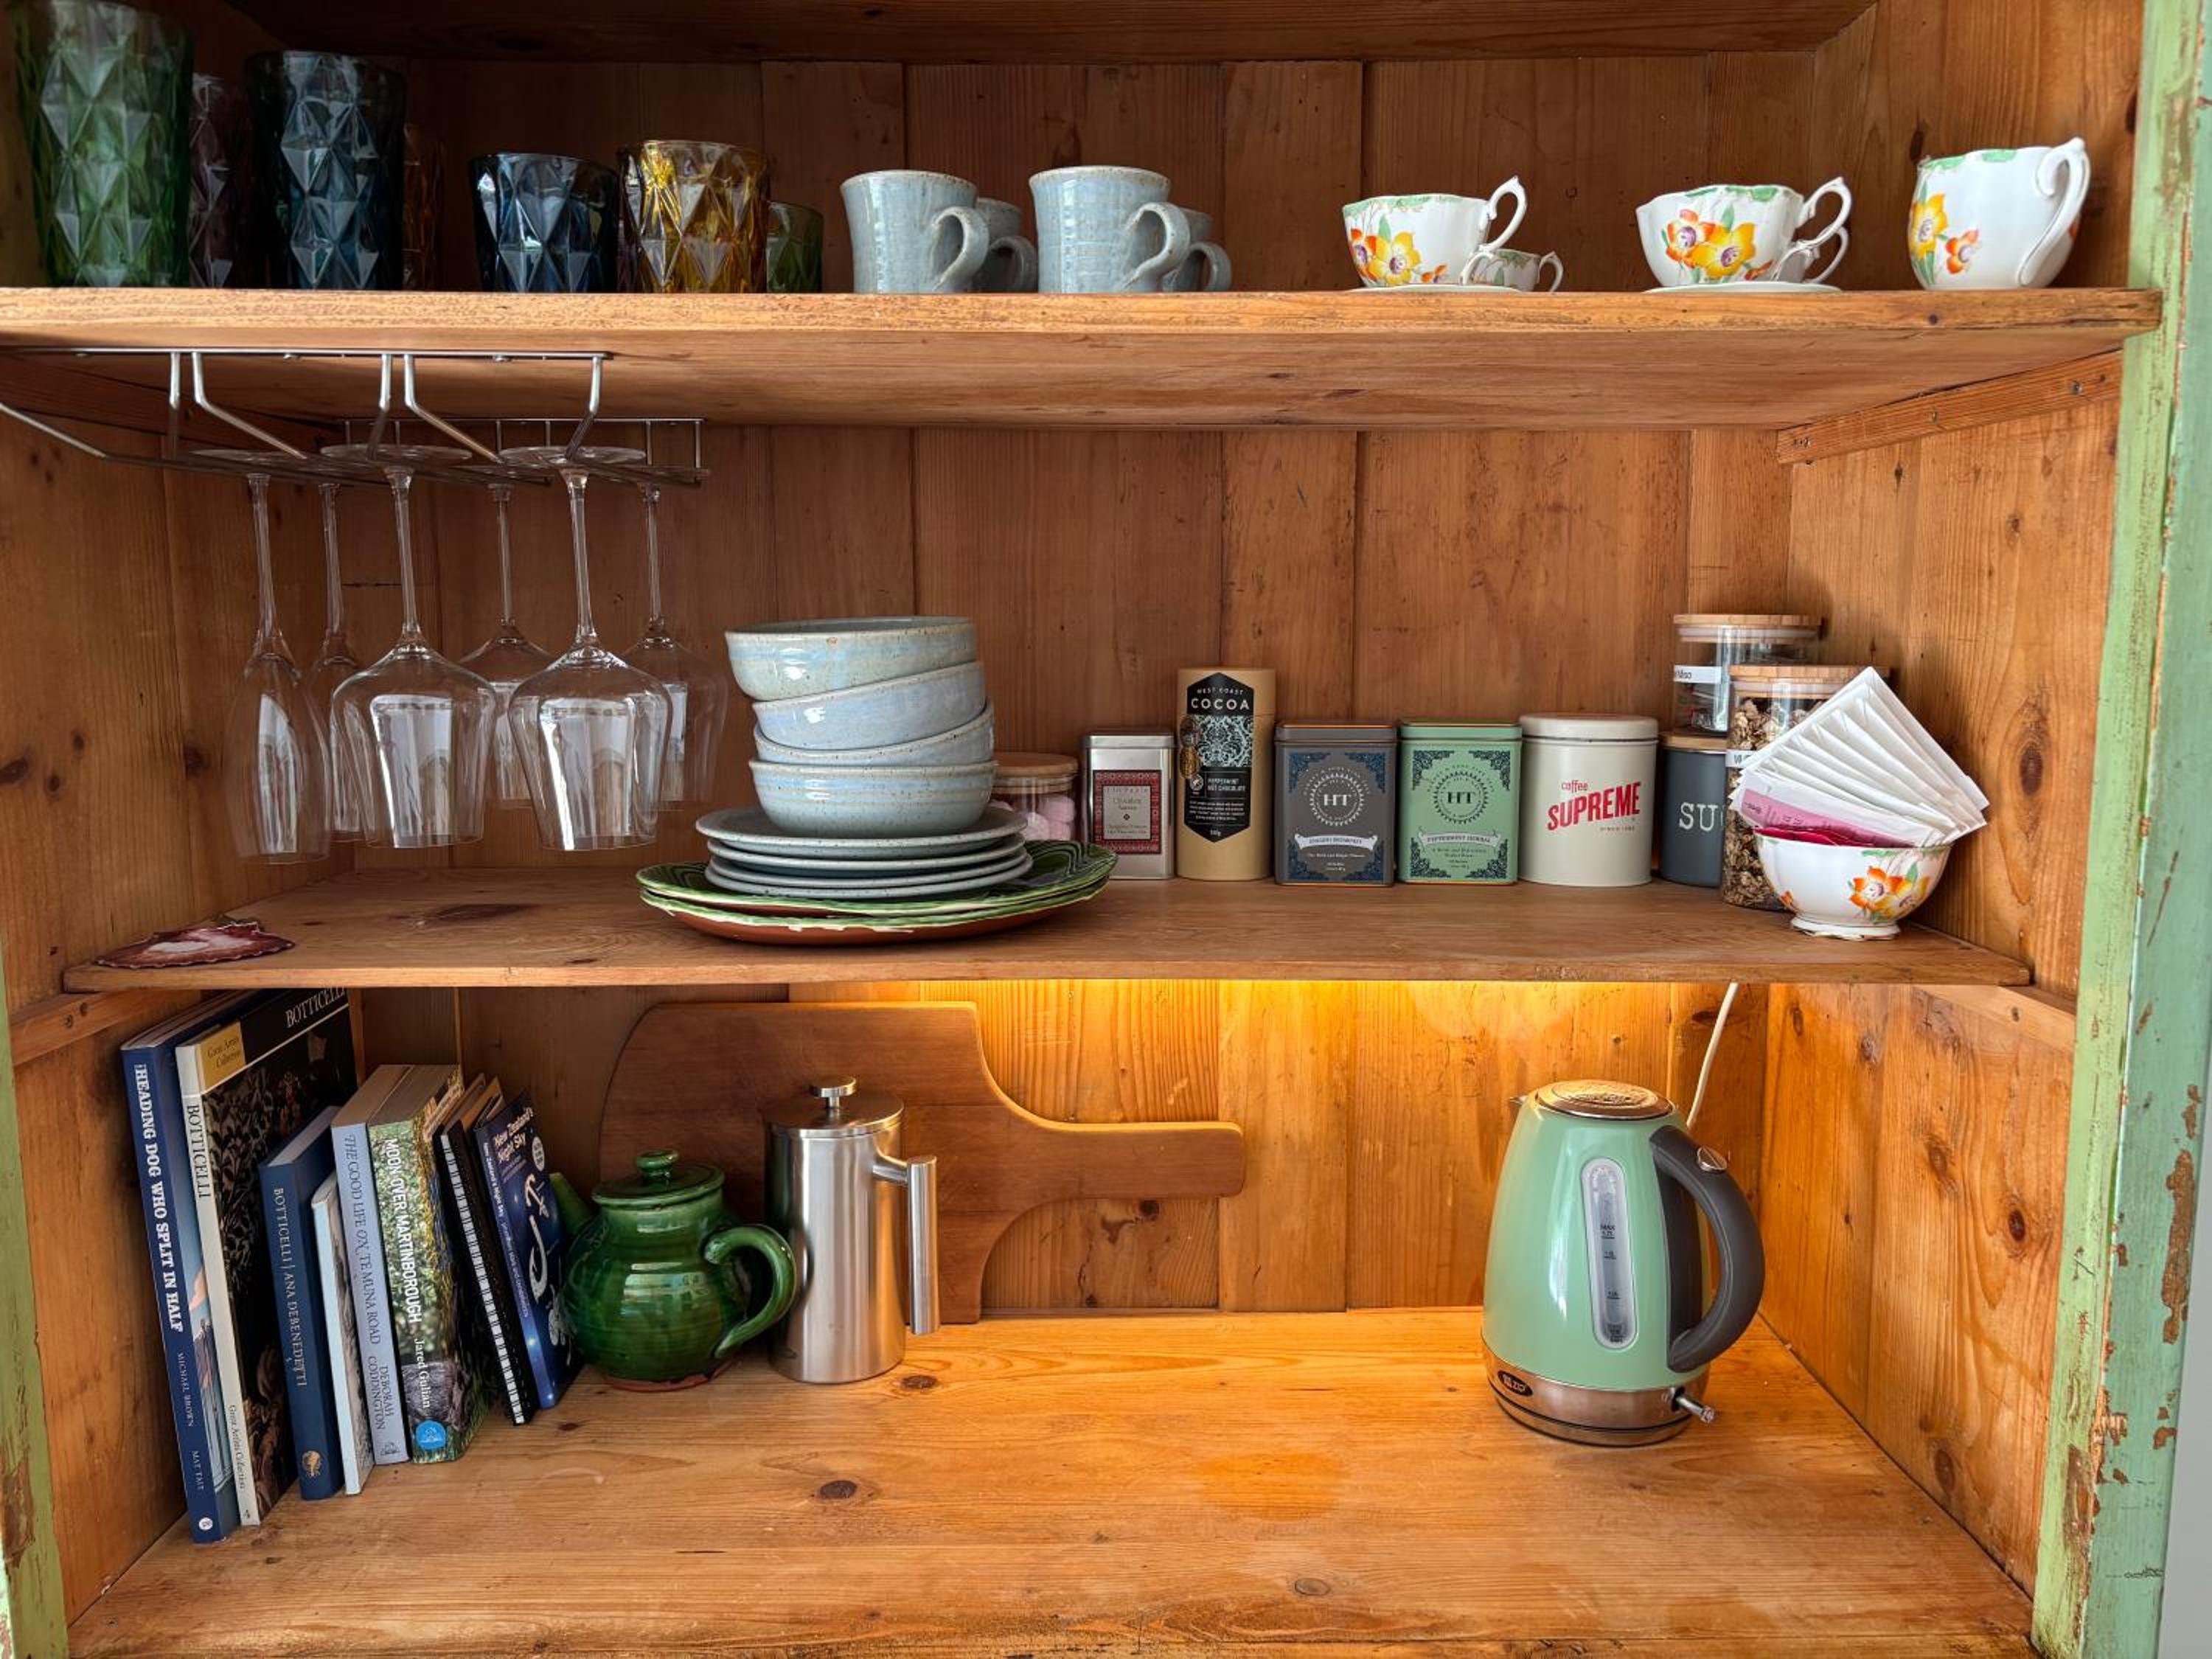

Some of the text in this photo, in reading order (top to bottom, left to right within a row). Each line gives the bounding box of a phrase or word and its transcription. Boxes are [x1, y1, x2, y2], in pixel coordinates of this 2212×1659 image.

[1191, 698, 1251, 710] COCOA
[1219, 687, 1244, 695] COAST
[1561, 779, 1589, 793] coffee
[1547, 782, 1641, 831] SUPREME
[1679, 802, 1724, 832] SU
[135, 1069, 156, 1139] HEADING
[145, 1142, 161, 1178] DOG
[187, 1105, 211, 1198] BOTTICELLI
[344, 1134, 358, 1160] THE
[151, 1180, 167, 1220] WHO
[347, 1161, 363, 1200] GOOD
[353, 1202, 366, 1227] LIFE
[384, 1138, 422, 1323] MOON OVER MARTINBOROUGH
[156, 1222, 174, 1268] SPLIT
[359, 1253, 372, 1270] TE
[163, 1270, 177, 1289] IN
[274, 1188, 307, 1386] BOTTICELLI ANA DEBENEDETTI
[361, 1271, 377, 1308] MUNA
[166, 1291, 184, 1333] HALF
[367, 1312, 380, 1344] ROAD
[177, 1352, 194, 1427] MICHAEL BROWN
[379, 1366, 394, 1416] DEBORAH
[414, 1338, 431, 1408] Jared Gulian
[369, 1356, 386, 1430] CODDINGTON
